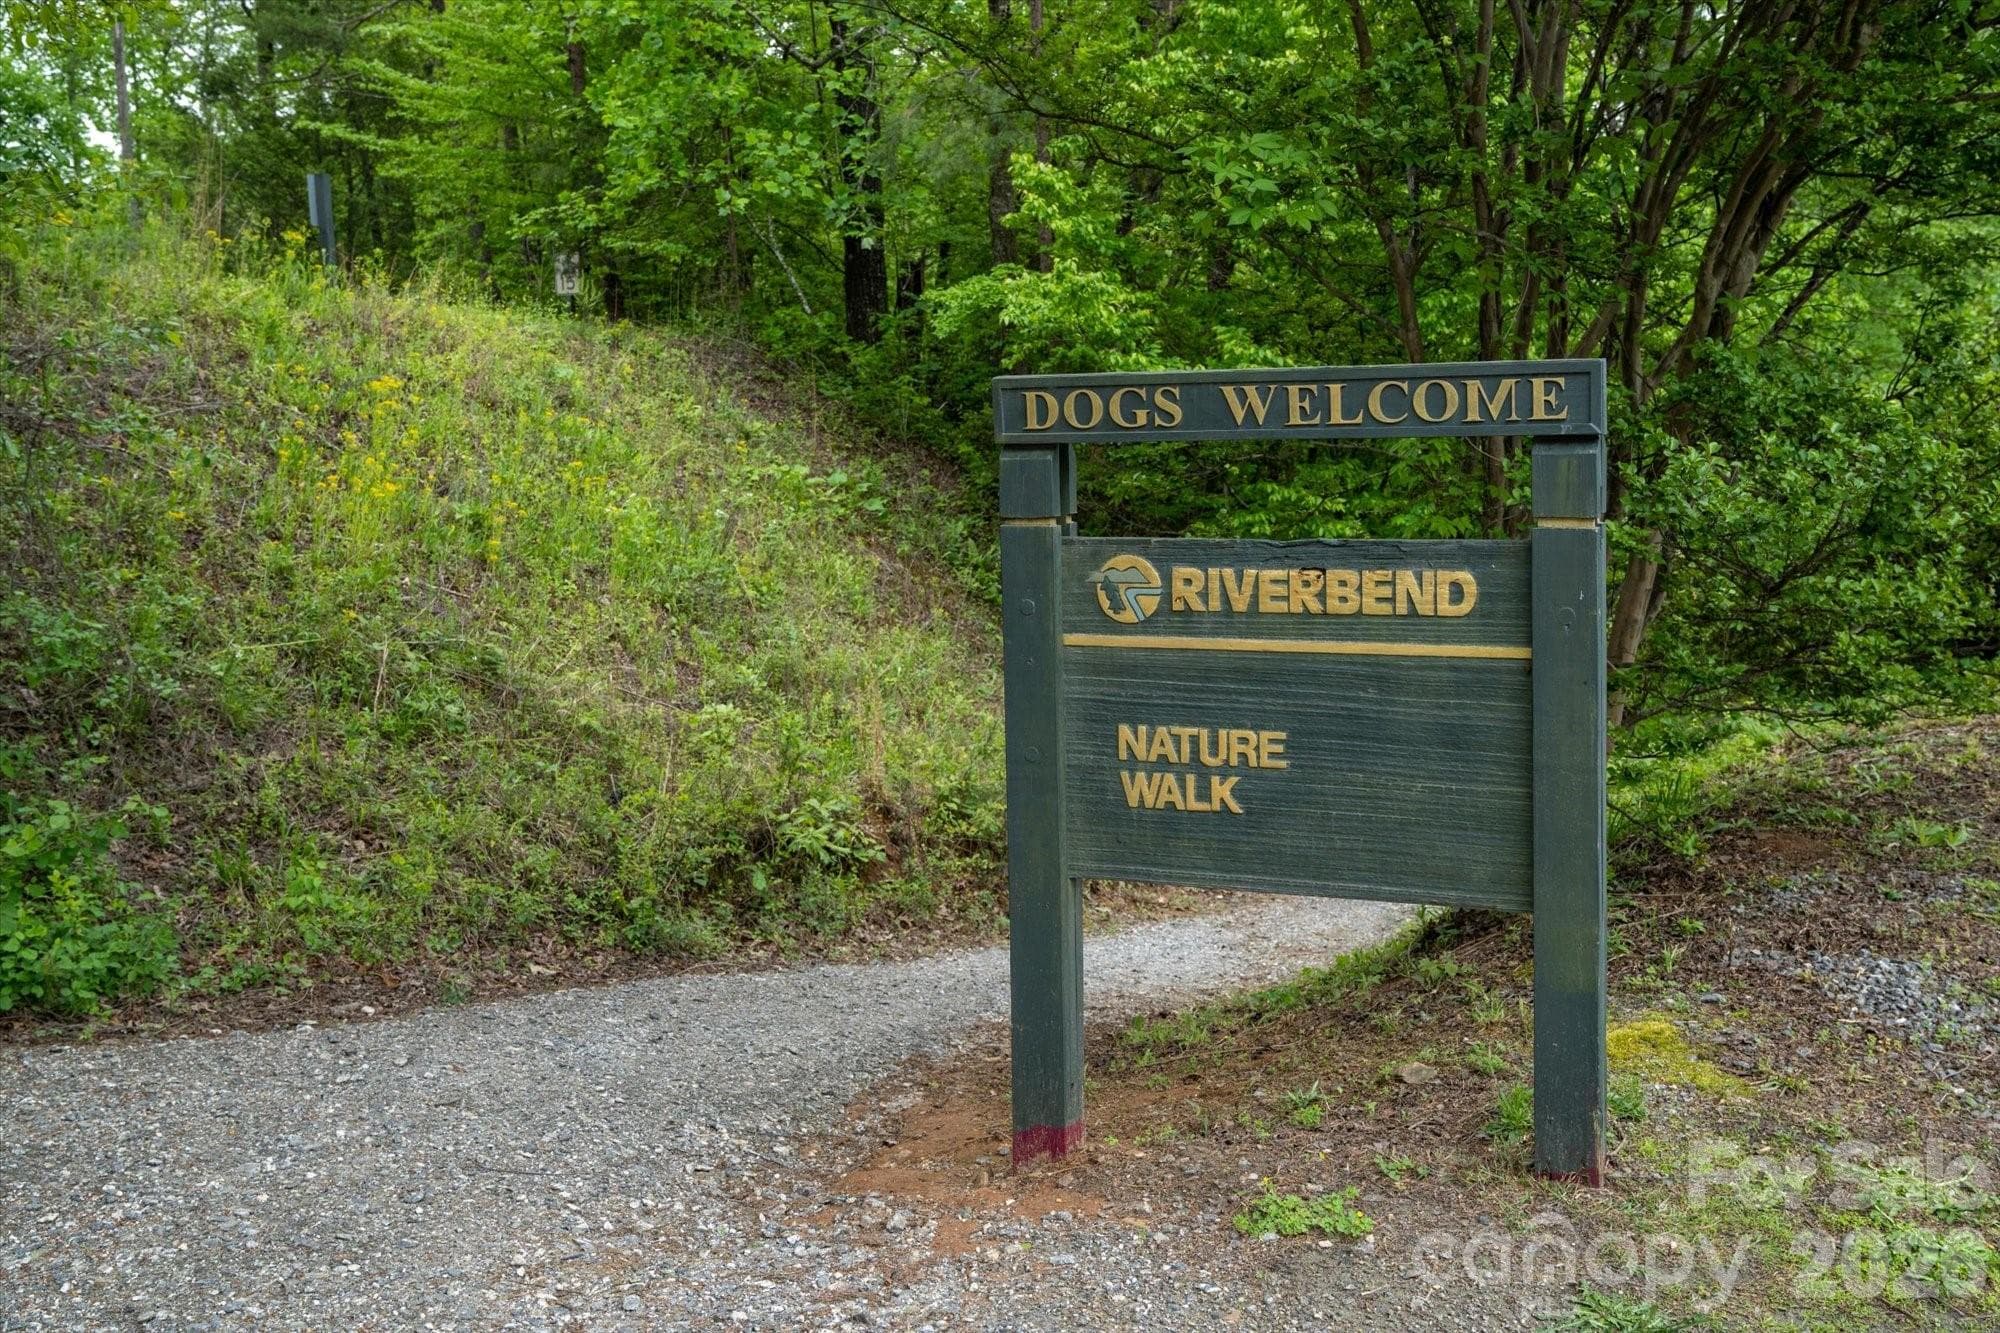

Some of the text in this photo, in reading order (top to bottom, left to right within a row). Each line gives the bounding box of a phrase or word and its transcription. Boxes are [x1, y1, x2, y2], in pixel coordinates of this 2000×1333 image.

[1022, 376, 1569, 431] DOGS WELCOME
[1171, 567, 1478, 617] RIVERBEND
[1117, 723, 1290, 769] NATURE
[1120, 771, 1244, 815] WALK
